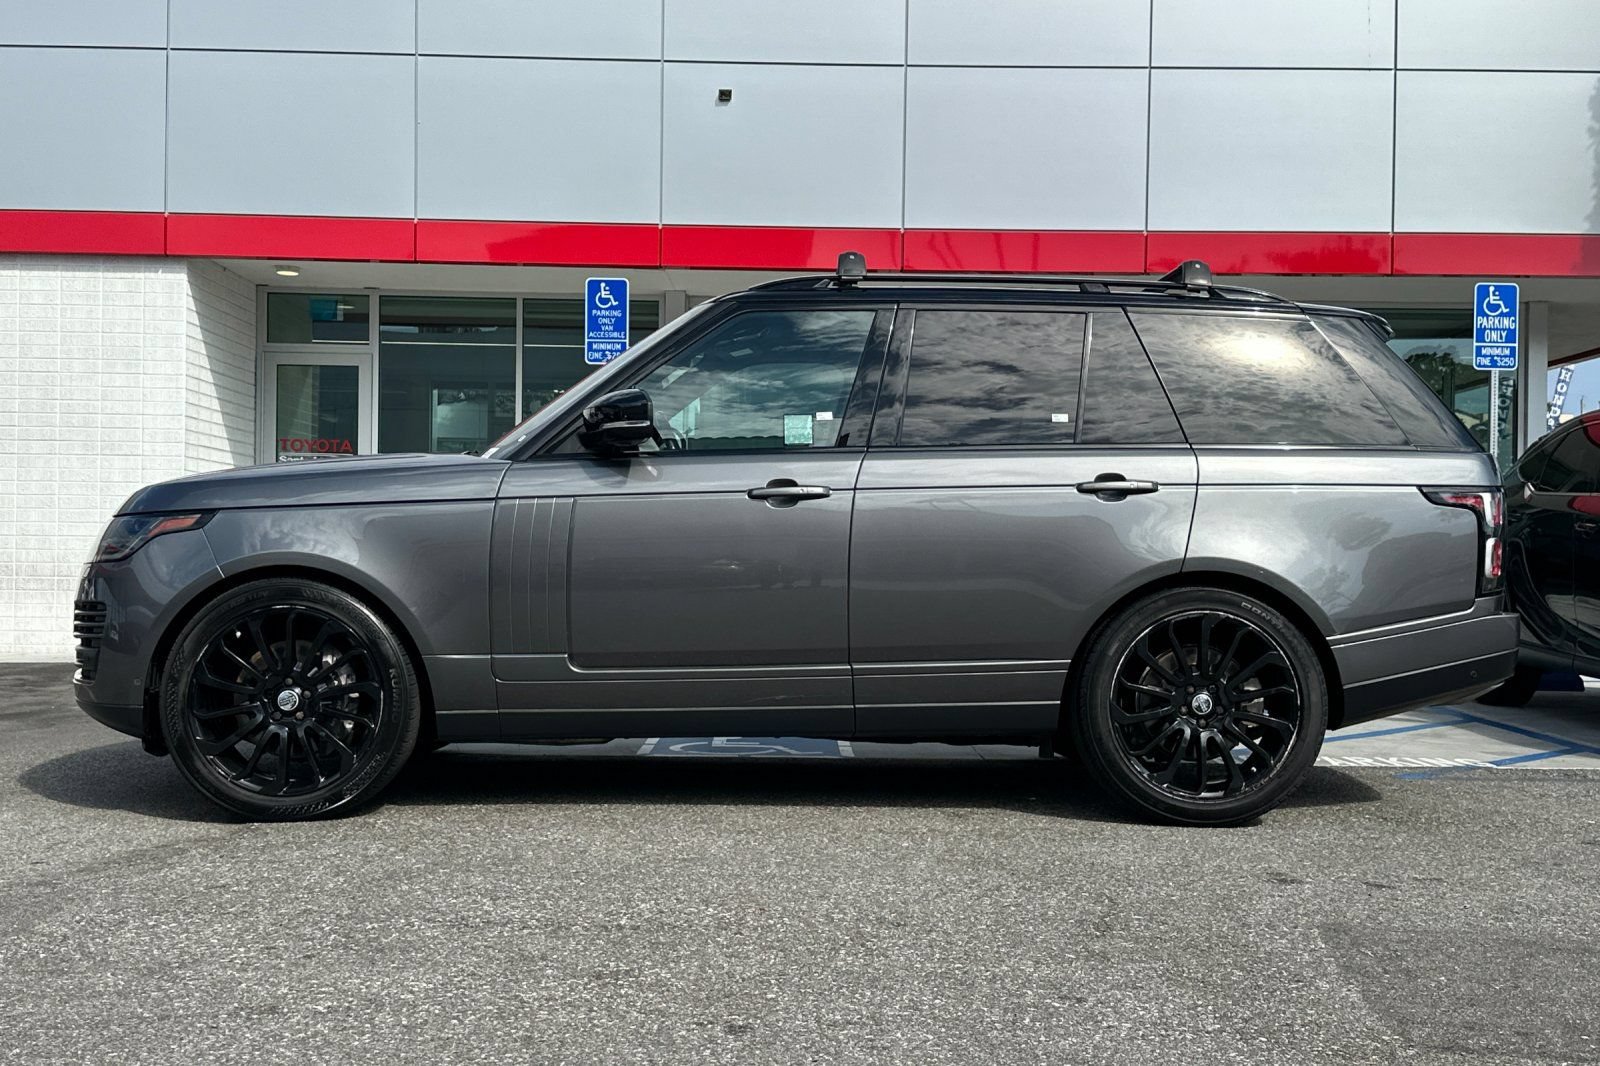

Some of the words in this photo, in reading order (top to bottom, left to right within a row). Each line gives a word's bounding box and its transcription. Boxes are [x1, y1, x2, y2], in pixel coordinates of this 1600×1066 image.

[592, 309, 621, 317] PARKING
[598, 317, 616, 325] ONLY
[1477, 316, 1515, 329] PARKING
[588, 331, 625, 339] ACCESSIBLE
[1484, 330, 1507, 342] ONLY
[592, 342, 621, 350] MINIMUM
[1481, 347, 1510, 355] MINIMUM
[1476, 357, 1491, 366] FINE
[280, 439, 353, 452] TOYOTA
[389, 668, 401, 723] KUMHO
[1316, 756, 1496, 768] ARKING
